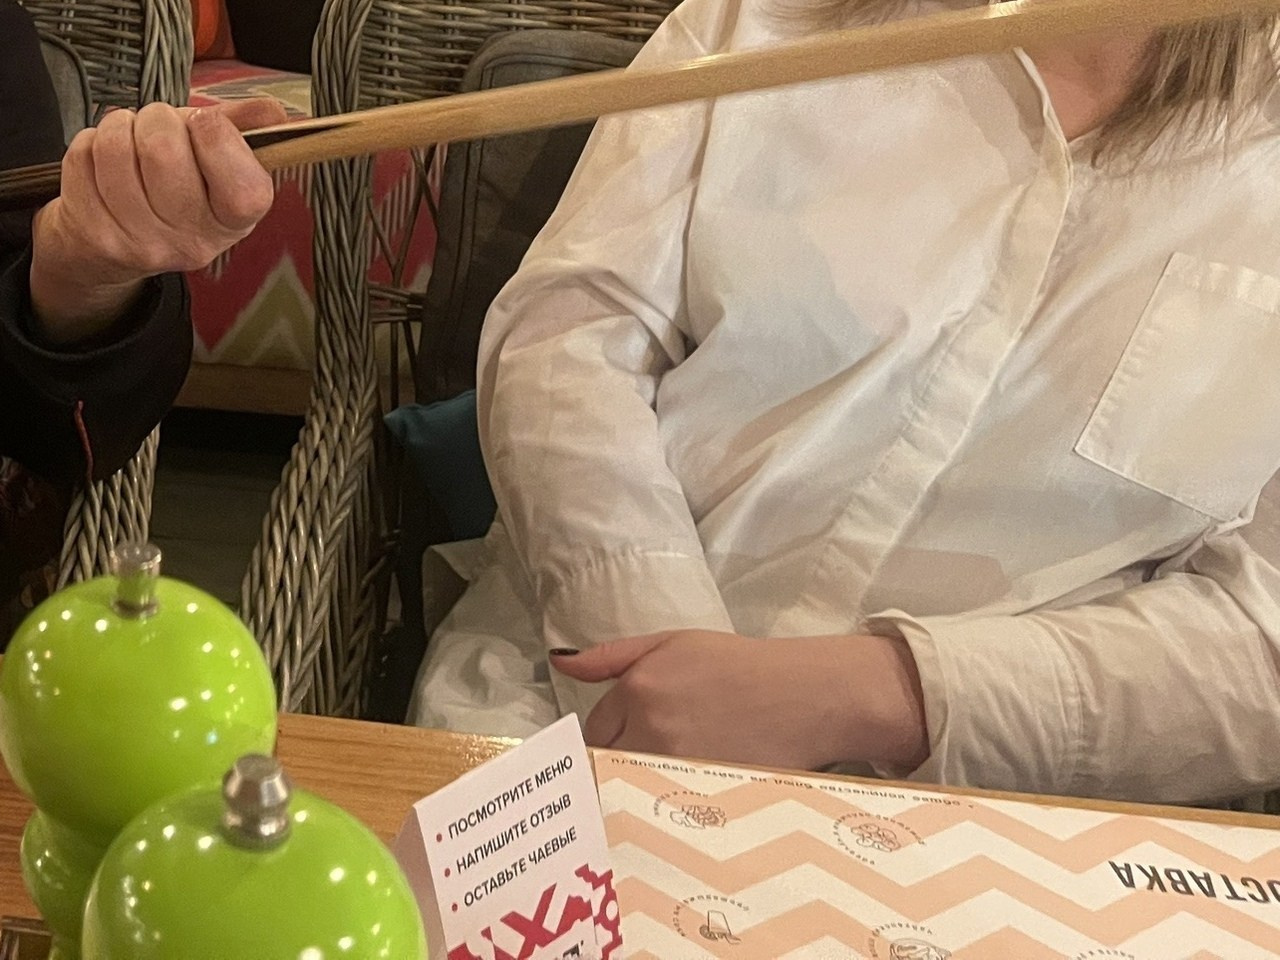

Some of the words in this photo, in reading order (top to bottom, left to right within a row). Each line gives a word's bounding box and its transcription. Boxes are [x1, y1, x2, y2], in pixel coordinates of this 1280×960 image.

[448, 778, 534, 840] ПОСМОТРИТЕ
[535, 755, 573, 788] МЕНЮ
[456, 819, 529, 875] НАПИШИТЕ
[529, 793, 572, 828] ОТЗЫВ
[464, 858, 528, 908] ОСТАВЬТЕ
[528, 826, 578, 865] ЧАЕВЫЕ
